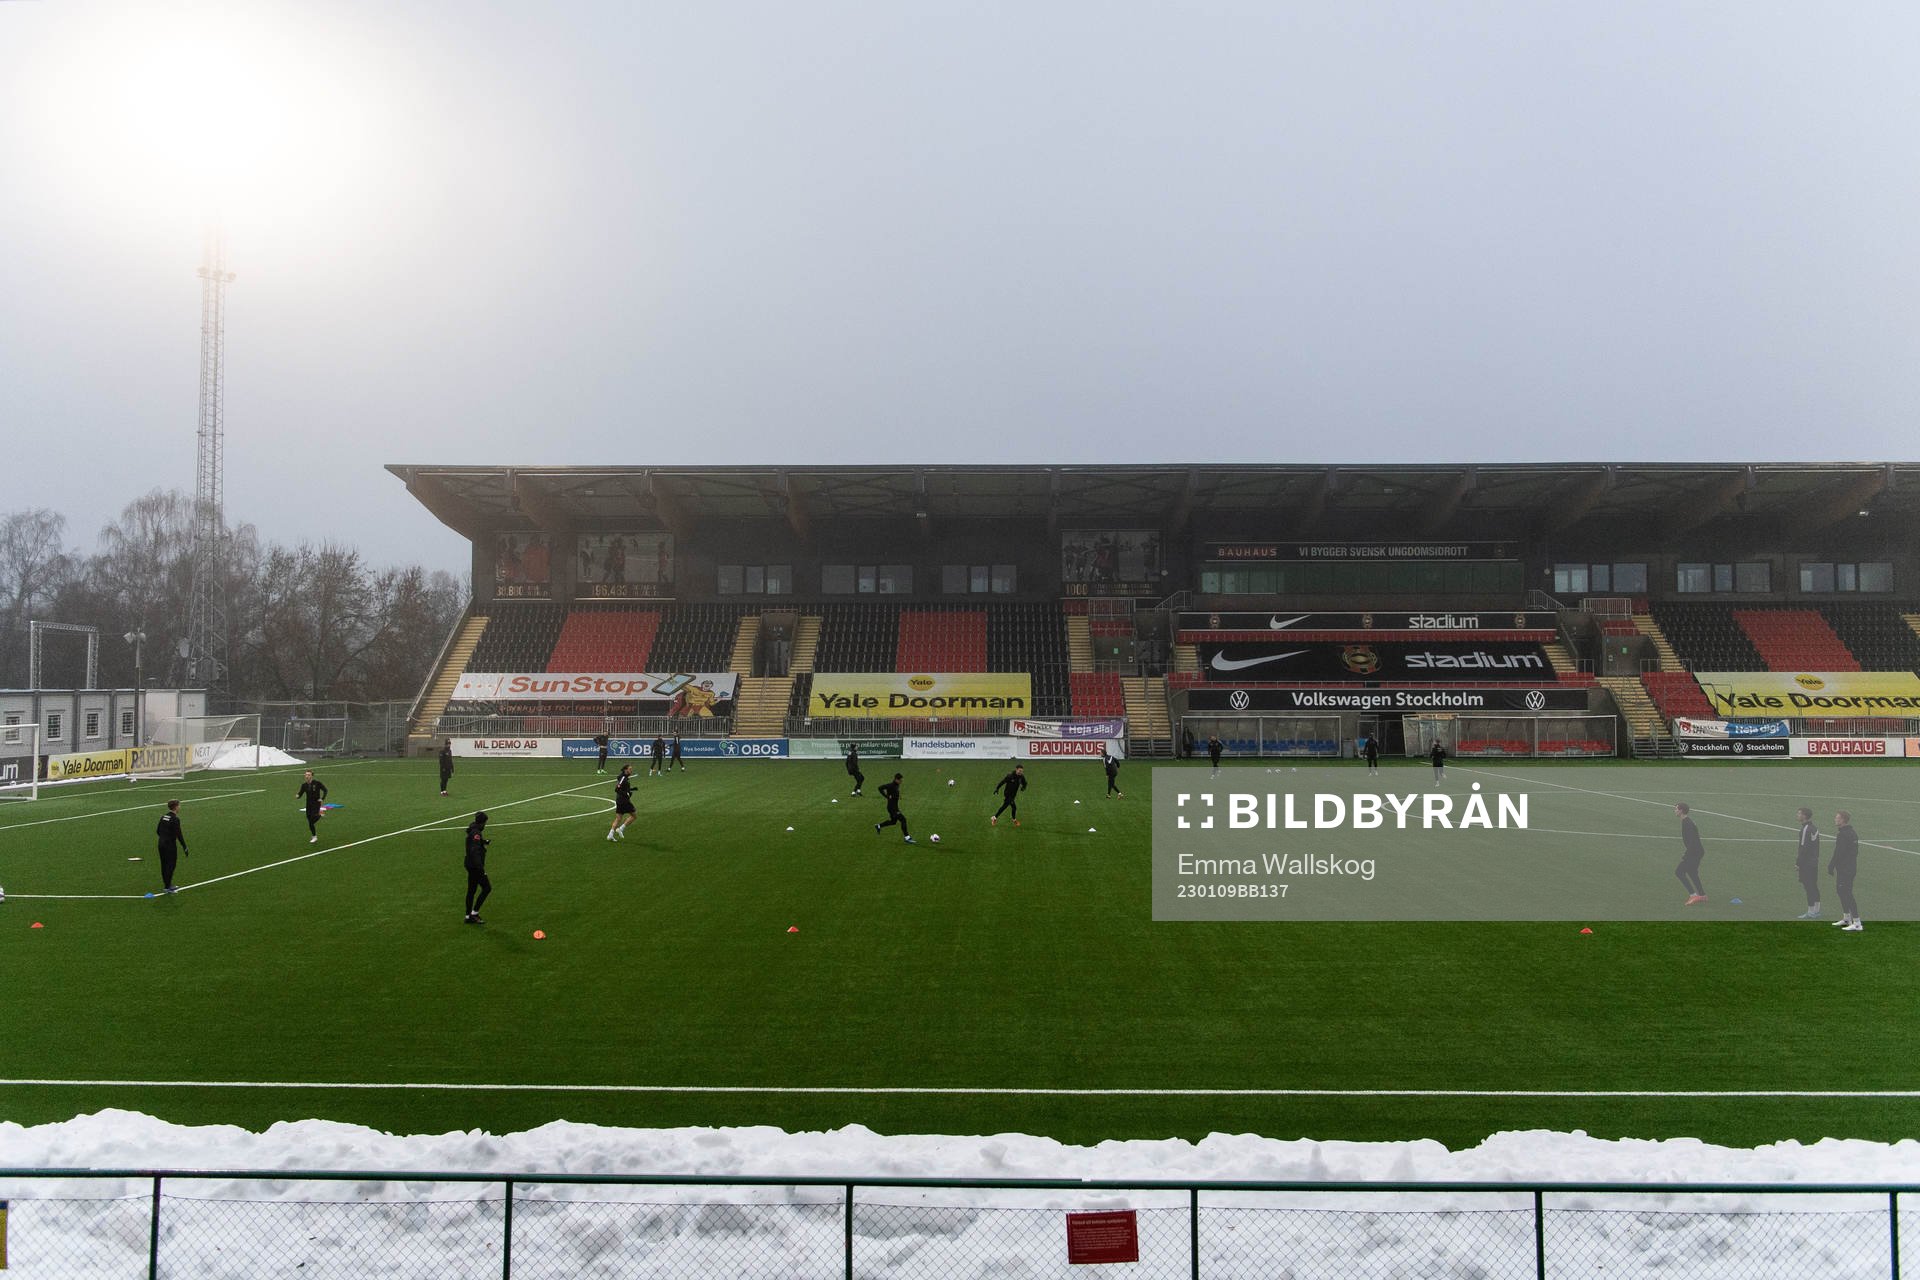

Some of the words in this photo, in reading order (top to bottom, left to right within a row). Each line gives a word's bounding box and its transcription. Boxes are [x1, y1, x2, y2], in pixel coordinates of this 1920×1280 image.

[1218, 548, 1277, 557] BAUHAUS
[1299, 546, 1308, 557] VI
[1311, 546, 1347, 557] BYGGER
[1350, 546, 1386, 557] SVENSK
[1388, 546, 1469, 557] UNGDOMSIDROTT
[1409, 614, 1478, 629] stadium
[1405, 651, 1544, 668] stadium
[508, 676, 648, 696] SunStop
[818, 693, 879, 709] Yale
[888, 693, 1024, 709] Doorman
[1292, 692, 1391, 710] Volkswagen
[1395, 692, 1484, 706] Stockholm
[1717, 693, 1784, 708] Yale
[474, 740, 489, 749] ML
[491, 740, 521, 749] DEMO
[523, 740, 538, 749] AB
[633, 744, 670, 756] OBS
[741, 744, 779, 755] OBOS
[910, 740, 976, 749] Handelsbanken
[1030, 741, 1105, 754] BAUHAUS
[1691, 743, 1730, 751] Stockholm
[1746, 743, 1785, 751] Stockholm
[1809, 742, 1885, 753] BAUHAUS
[131, 747, 190, 769] RAMIRENT
[63, 760, 81, 775] Yale
[84, 758, 123, 772] Doorman
